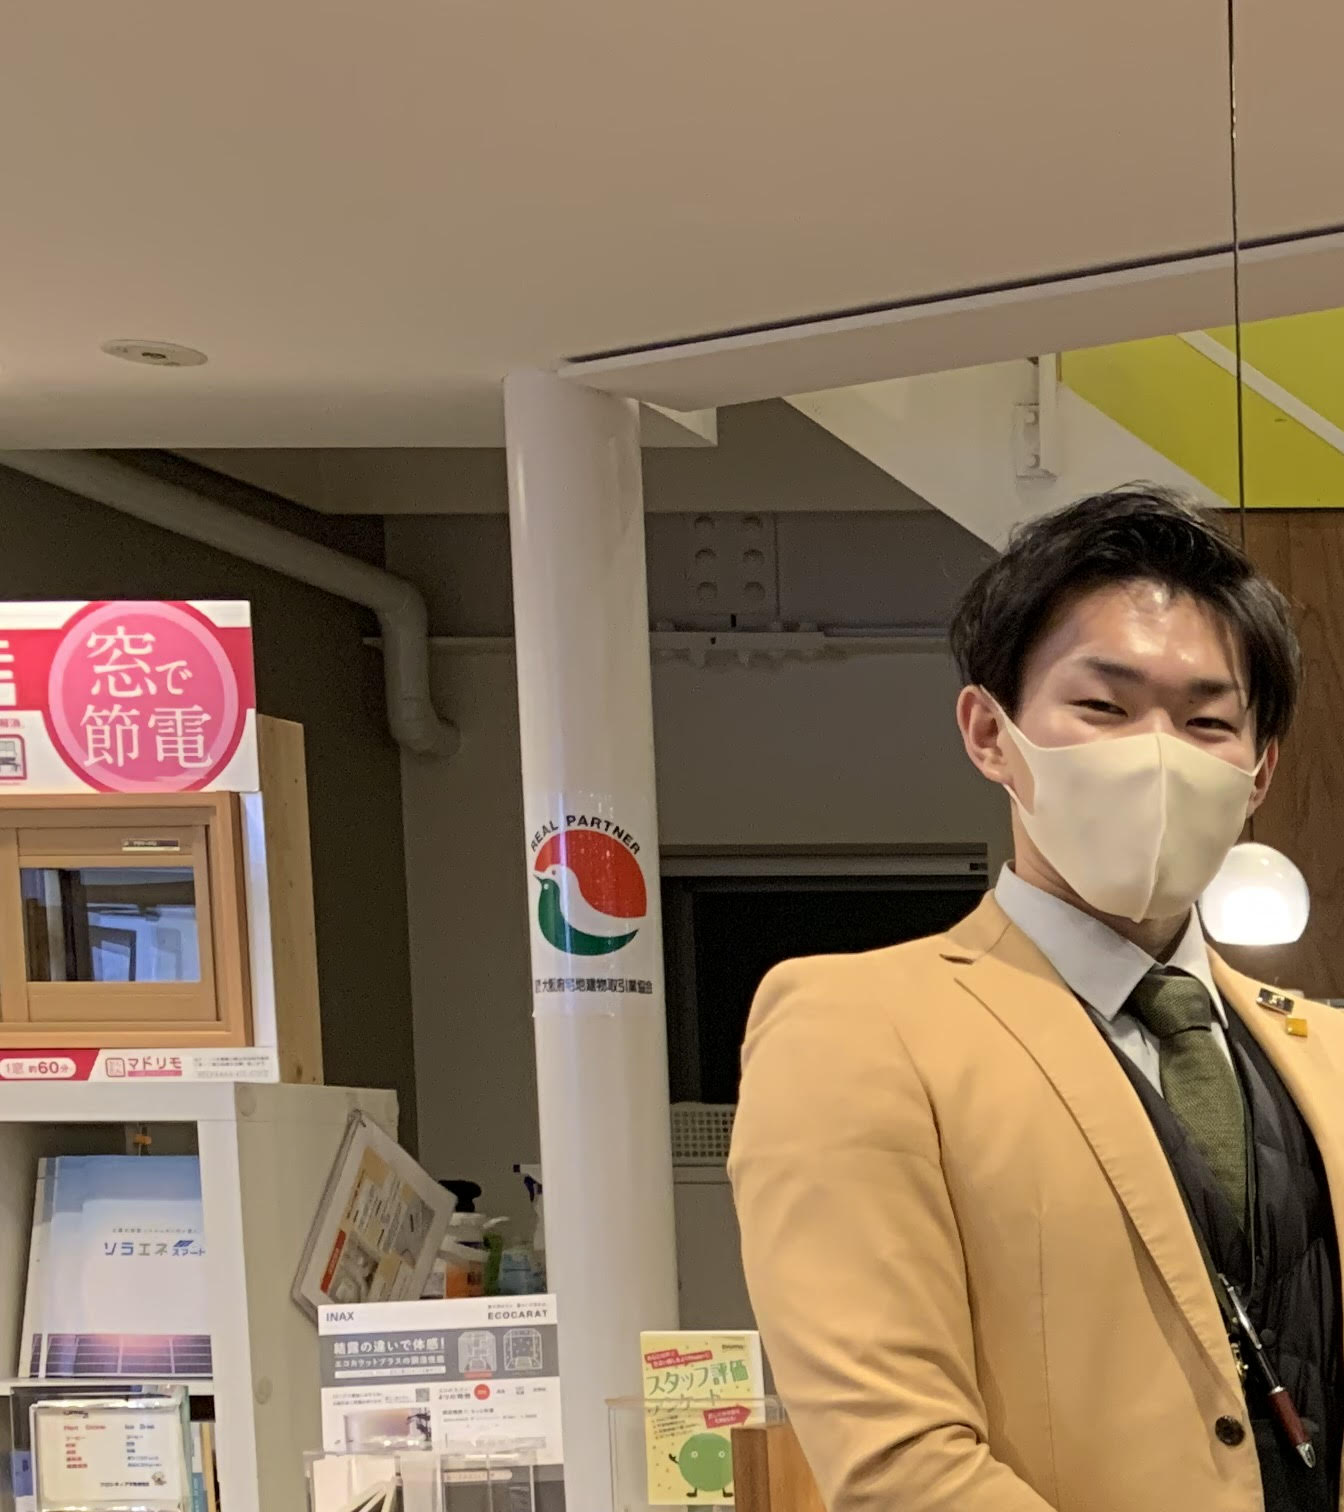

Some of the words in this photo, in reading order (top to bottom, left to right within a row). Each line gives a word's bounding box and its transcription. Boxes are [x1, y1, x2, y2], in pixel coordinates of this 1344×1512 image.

[86, 625, 193, 698] 窓で
[79, 703, 214, 769] 節電
[530, 820, 559, 853] REAL
[565, 814, 641, 855] PARTNER
[127, 1056, 183, 1070] マドリモ
[103, 1241, 168, 1257] ソラエネ
[325, 1311, 355, 1323] INAX
[487, 1308, 549, 1321] ECOCARAT
[645, 1359, 750, 1396] スタッフ評価
